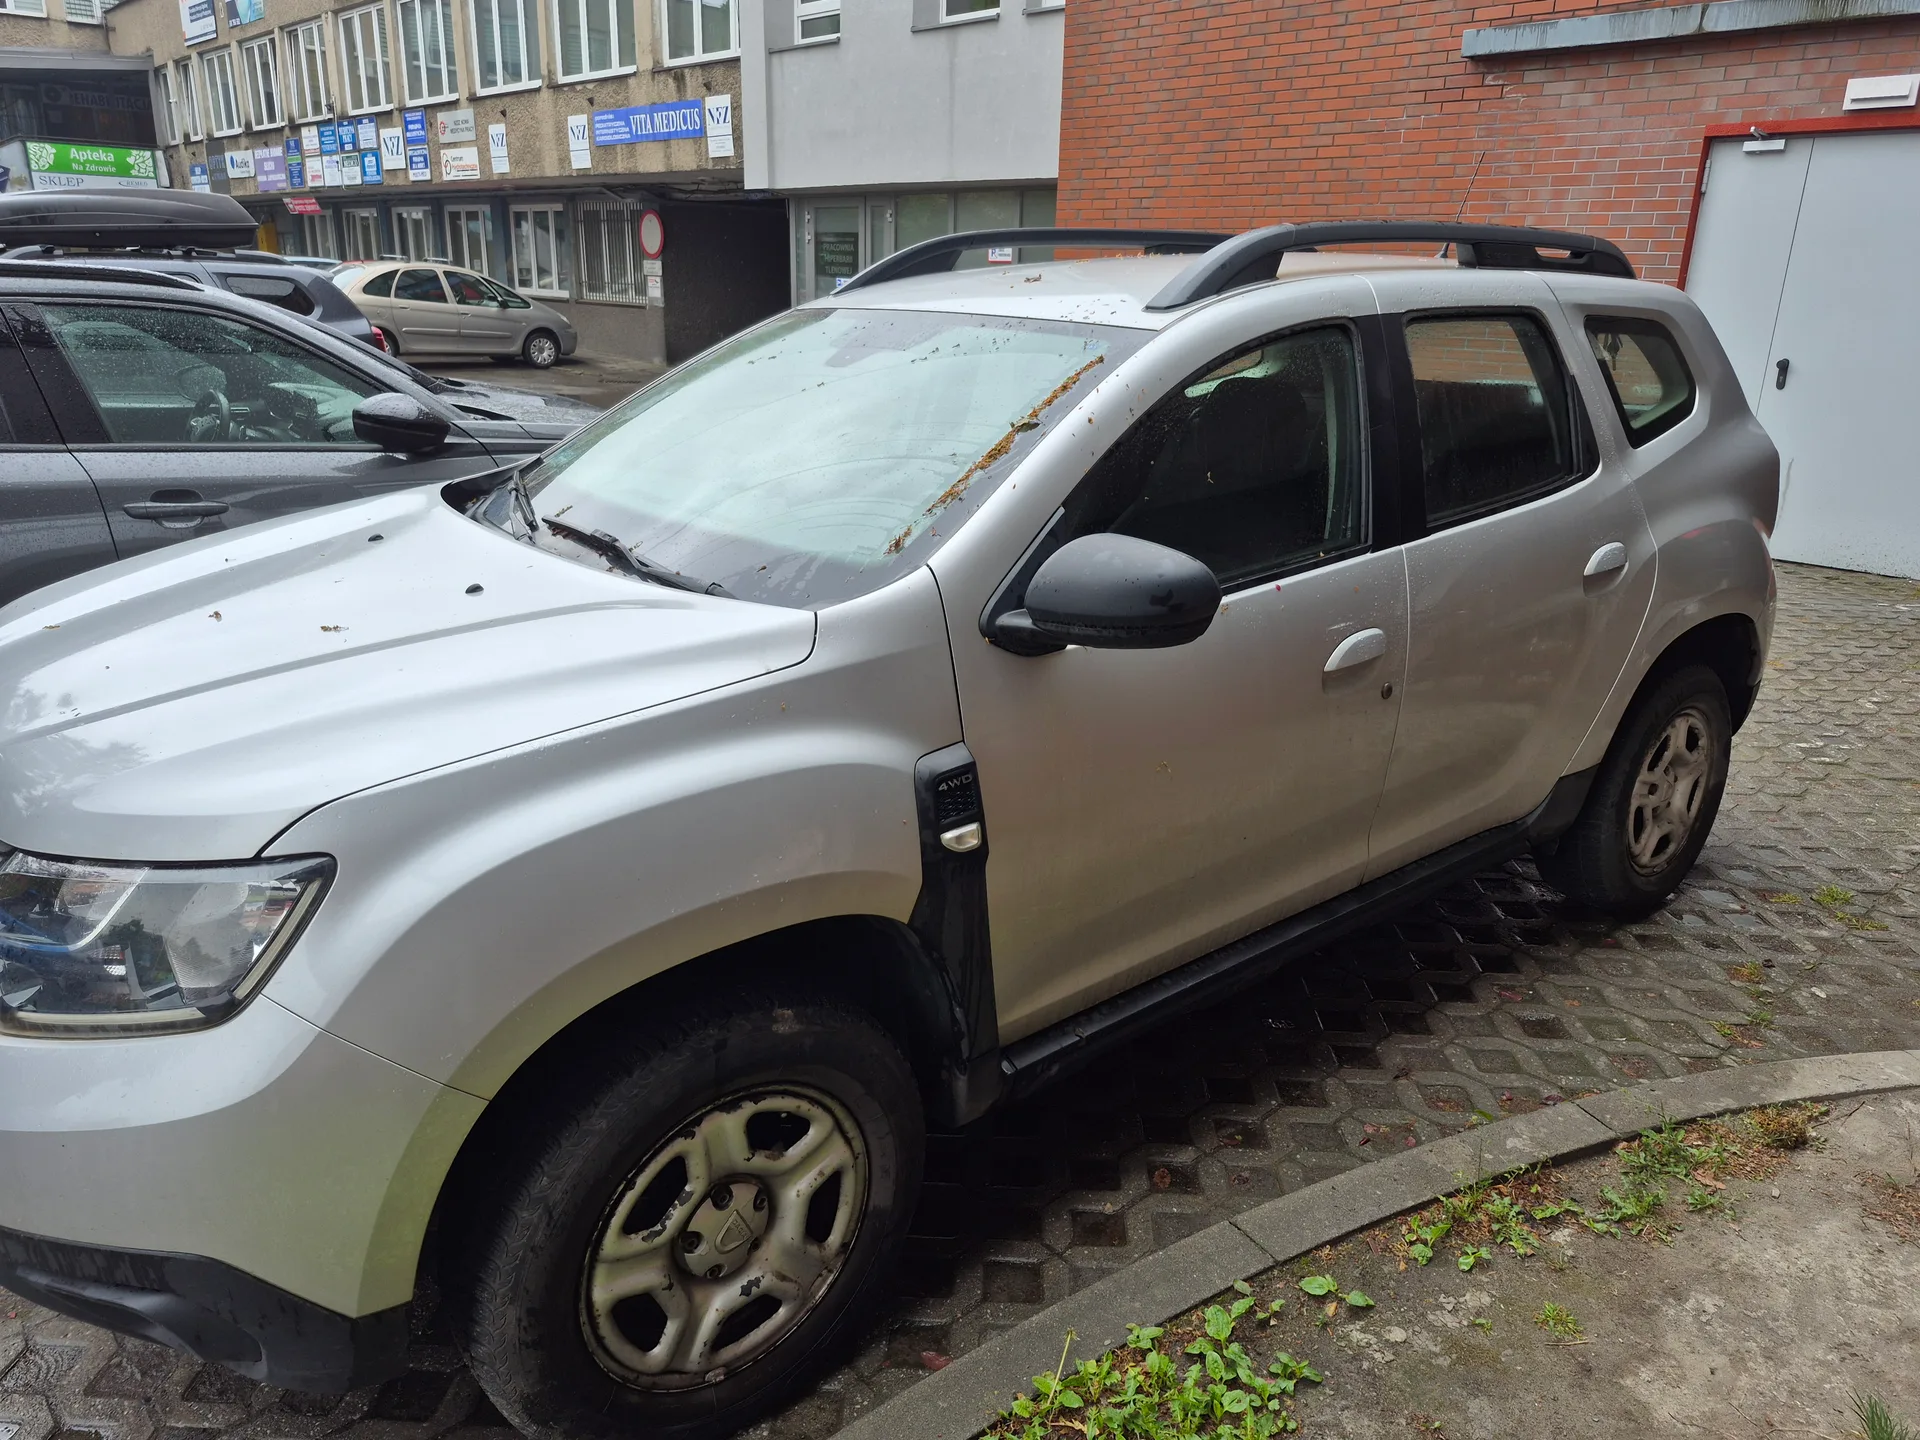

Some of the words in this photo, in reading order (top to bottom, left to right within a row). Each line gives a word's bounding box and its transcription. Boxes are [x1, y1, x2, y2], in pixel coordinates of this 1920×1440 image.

[629, 114, 653, 135] VITA
[653, 107, 700, 133] MEDICUS
[708, 105, 730, 124] NFZ
[490, 133, 506, 147] NFZ
[570, 124, 588, 141] NFZ
[383, 135, 403, 157] NFZ
[70, 148, 115, 163] Apteka
[72, 163, 83, 171] Na
[85, 164, 117, 173] Zdrowie
[39, 176, 84, 187] SKLEP
[822, 243, 855, 252] PRACOWNIA
[938, 774, 973, 791] 4WD
